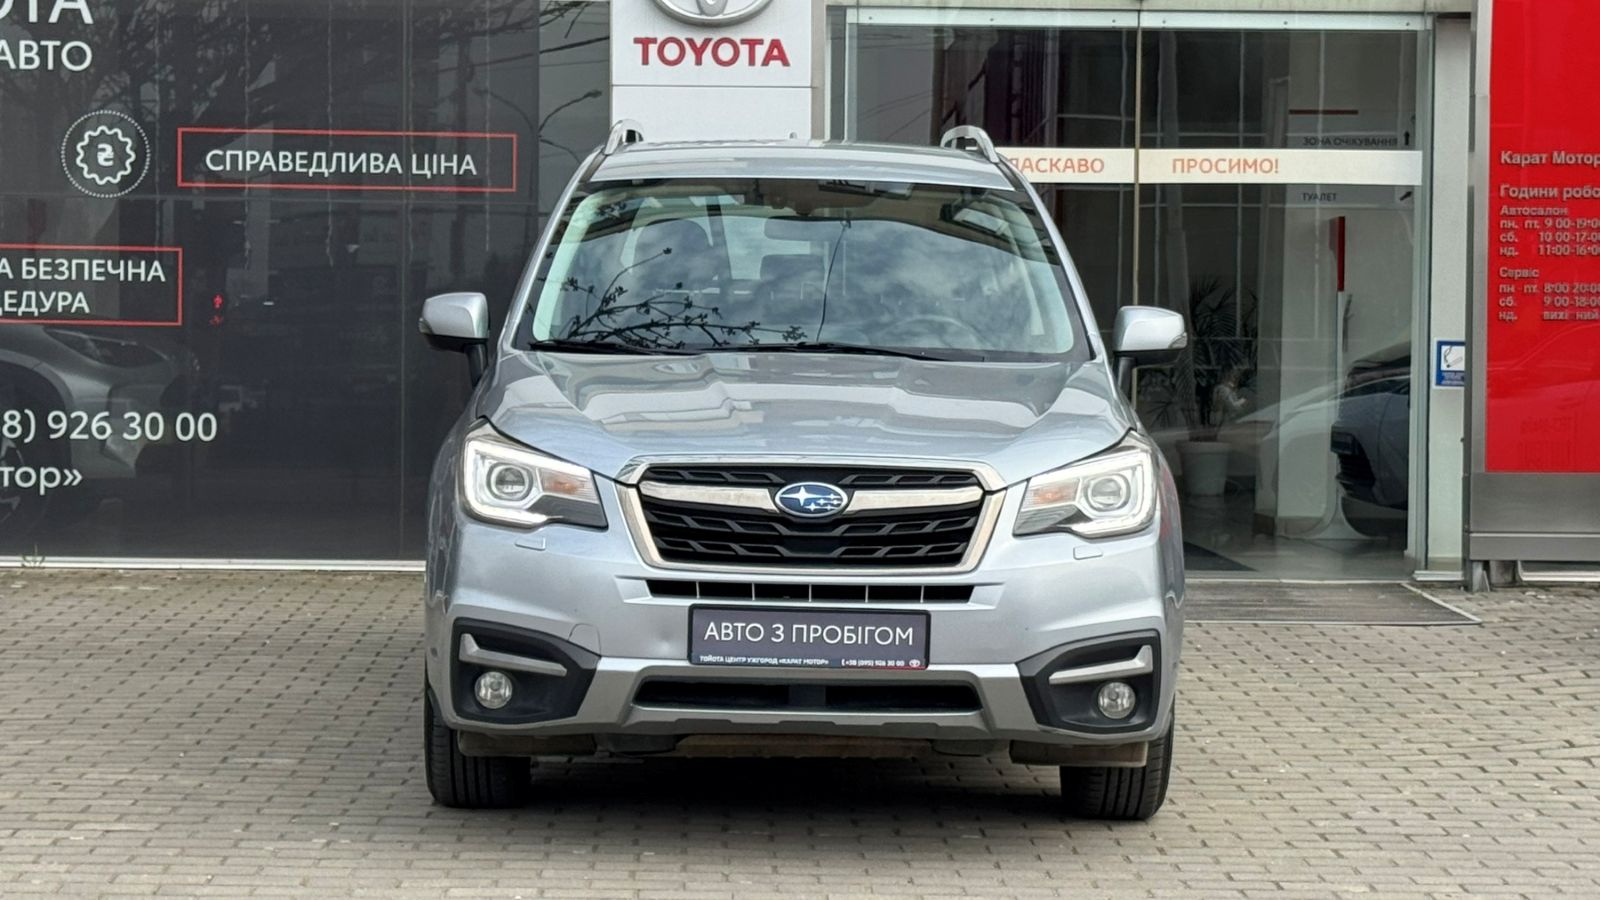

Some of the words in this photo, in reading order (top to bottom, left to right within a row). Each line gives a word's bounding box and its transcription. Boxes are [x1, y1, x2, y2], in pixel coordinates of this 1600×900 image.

[0, 40, 92, 71] АВТО
[633, 37, 790, 67] TOYOTA
[205, 149, 403, 177] СПРАВЕДЛИВА
[411, 153, 477, 178] ЦІНА
[1172, 158, 1279, 174] ПРОСИМО!
[1501, 151, 1547, 168] Карат
[1552, 151, 1600, 168] Мотор
[1302, 192, 1336, 201] ТУАЛЕТ
[1500, 184, 1558, 199] Години
[1500, 205, 1568, 216] Автосалон
[22, 258, 166, 282] БЕЗПЕЧНА
[0, 290, 90, 316] ЕДУРА
[2, 409, 36, 443] 8)
[47, 411, 113, 440] 926
[122, 412, 165, 441] 30
[175, 412, 218, 441] 00
[704, 622, 764, 642] АВТО
[792, 625, 913, 645] ПРОБІГОМ
